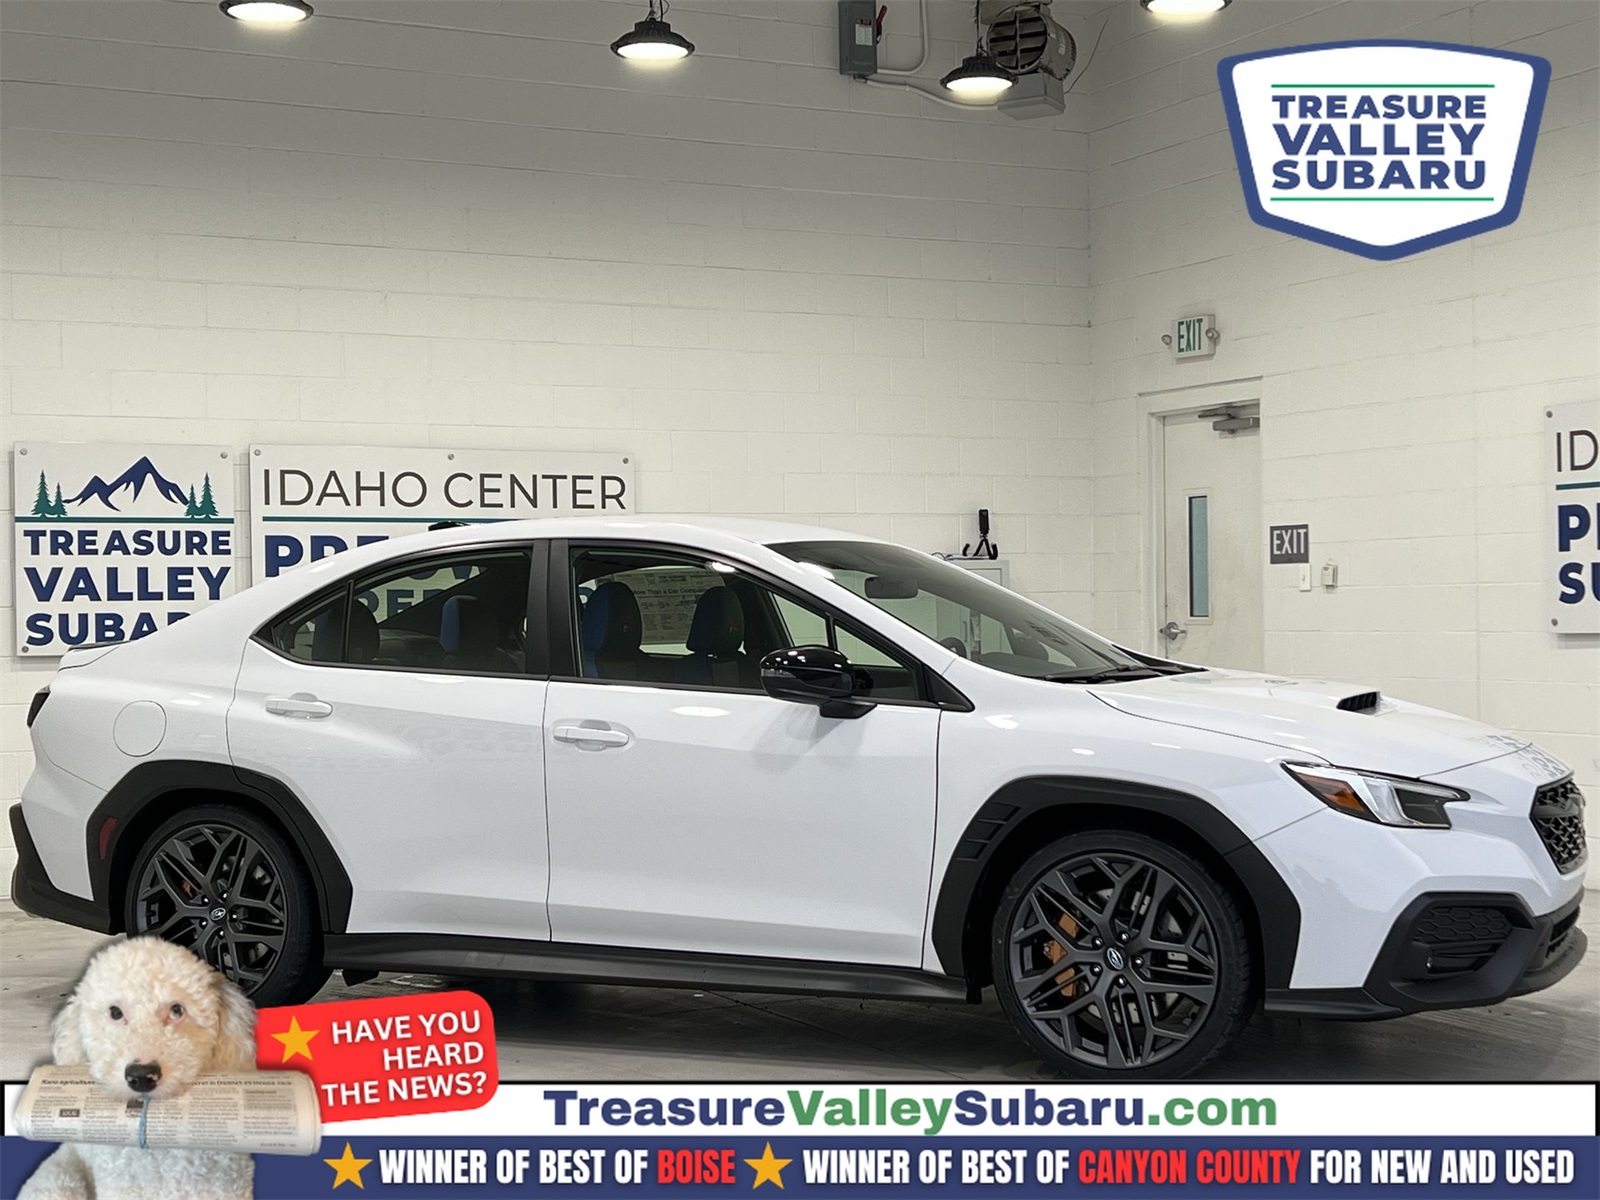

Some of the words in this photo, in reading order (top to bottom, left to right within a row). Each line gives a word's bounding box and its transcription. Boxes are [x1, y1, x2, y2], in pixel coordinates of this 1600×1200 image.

[1177, 318, 1204, 353] EXIT
[263, 468, 428, 508] IDAHO
[443, 472, 627, 510] CENTER
[23, 529, 233, 556] TREASURE
[1272, 528, 1307, 556] EXIT
[1557, 503, 1600, 552] P
[23, 566, 232, 602] VALLEY
